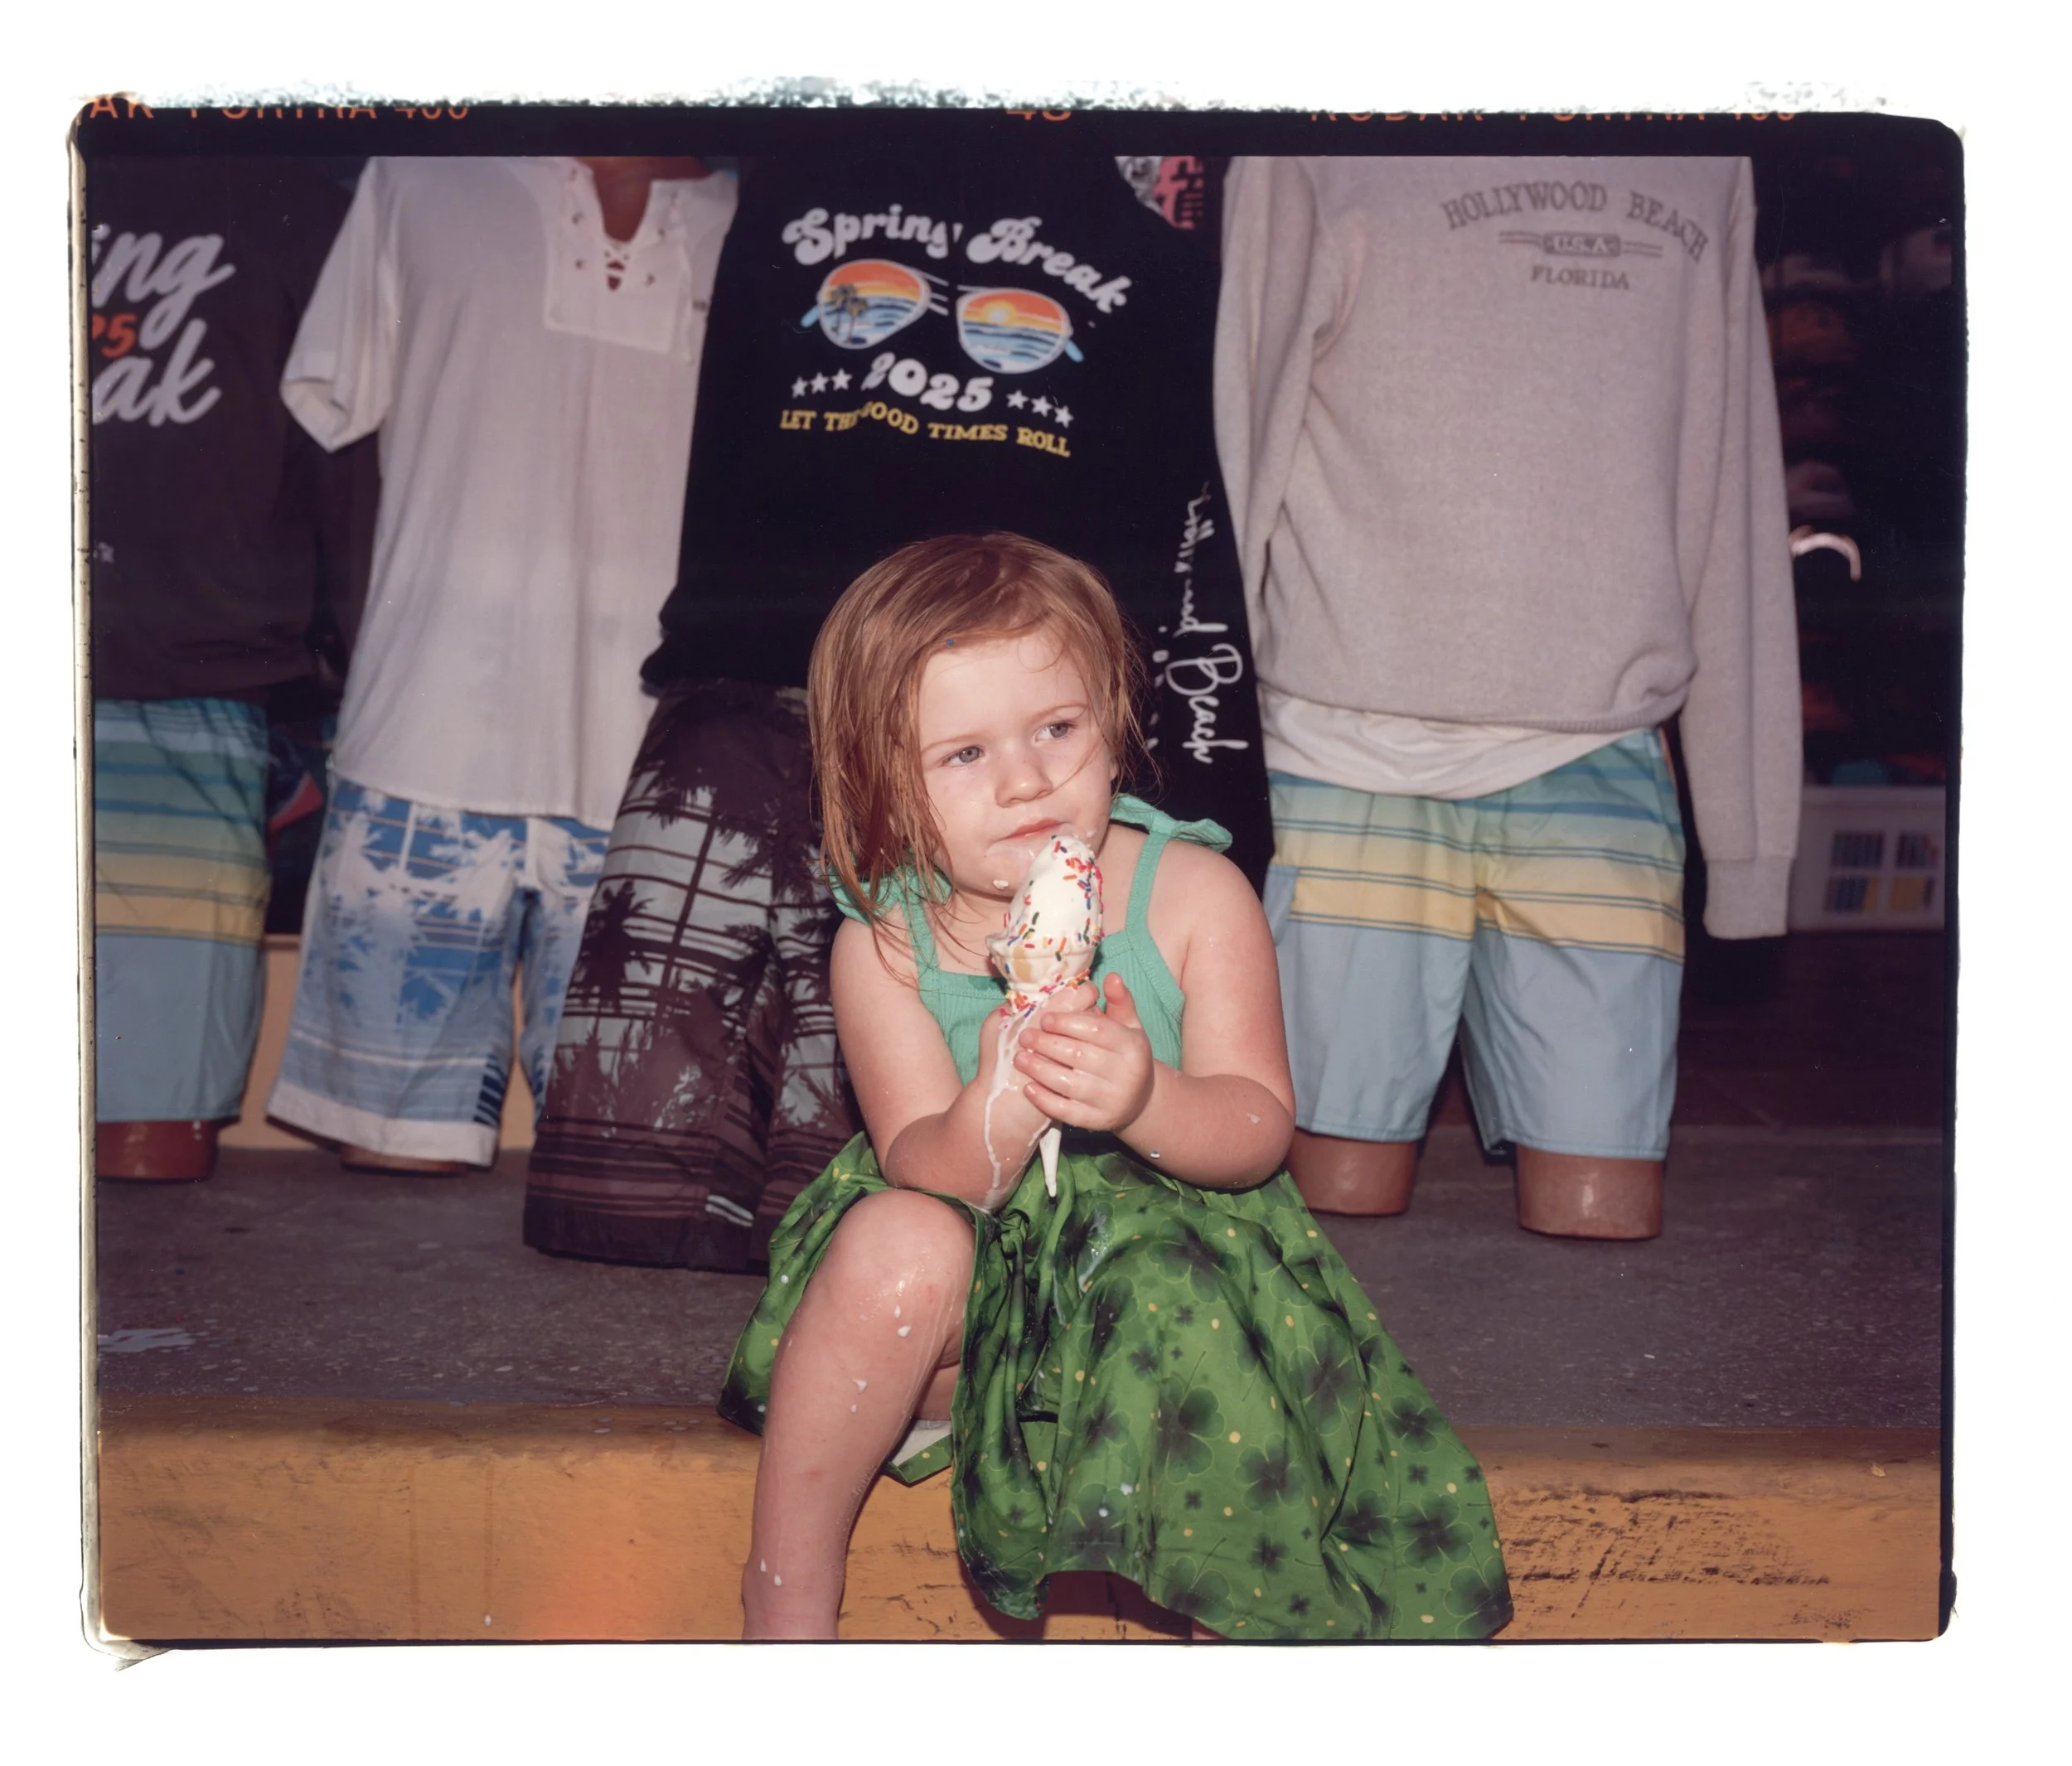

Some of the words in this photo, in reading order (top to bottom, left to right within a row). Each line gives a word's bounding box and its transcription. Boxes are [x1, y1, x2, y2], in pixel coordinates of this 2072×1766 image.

[782, 203, 964, 266] Spring
[966, 216, 1132, 313] Break
[1440, 181, 1608, 230] HOLLYWOOD
[1625, 189, 1709, 264] BEACH
[1531, 264, 1629, 290] FLORIDA
[861, 351, 995, 412] 2025
[779, 409, 818, 431] LET
[859, 400, 920, 435] OOD
[927, 423, 1009, 441] TIMES
[1016, 426, 1072, 457] ROLL
[1164, 643, 1249, 764] Beach
